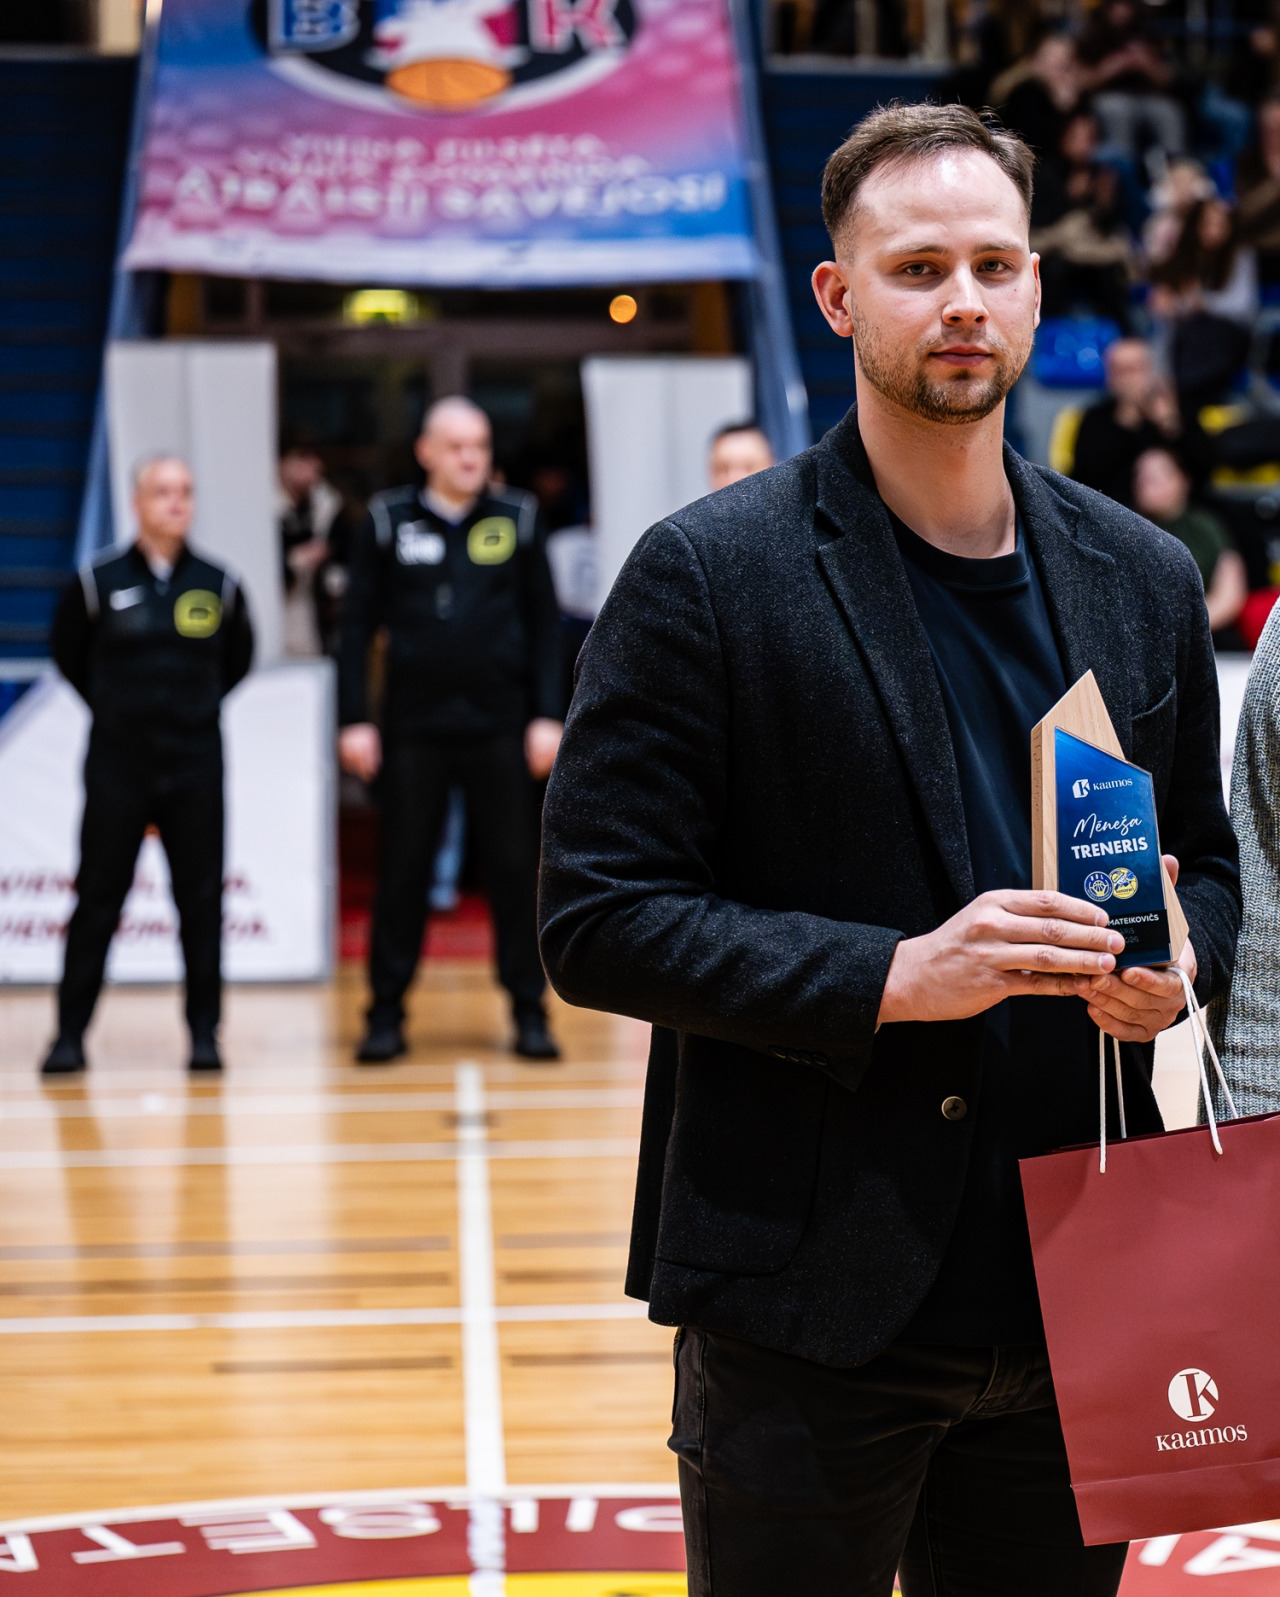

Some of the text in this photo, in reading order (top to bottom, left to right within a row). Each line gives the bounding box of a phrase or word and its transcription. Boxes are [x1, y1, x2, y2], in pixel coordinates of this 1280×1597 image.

[1073, 813, 1142, 838] Mēneša
[1071, 837, 1148, 859] TRENERIS
[1107, 913, 1159, 926] MATEIKOVIČS
